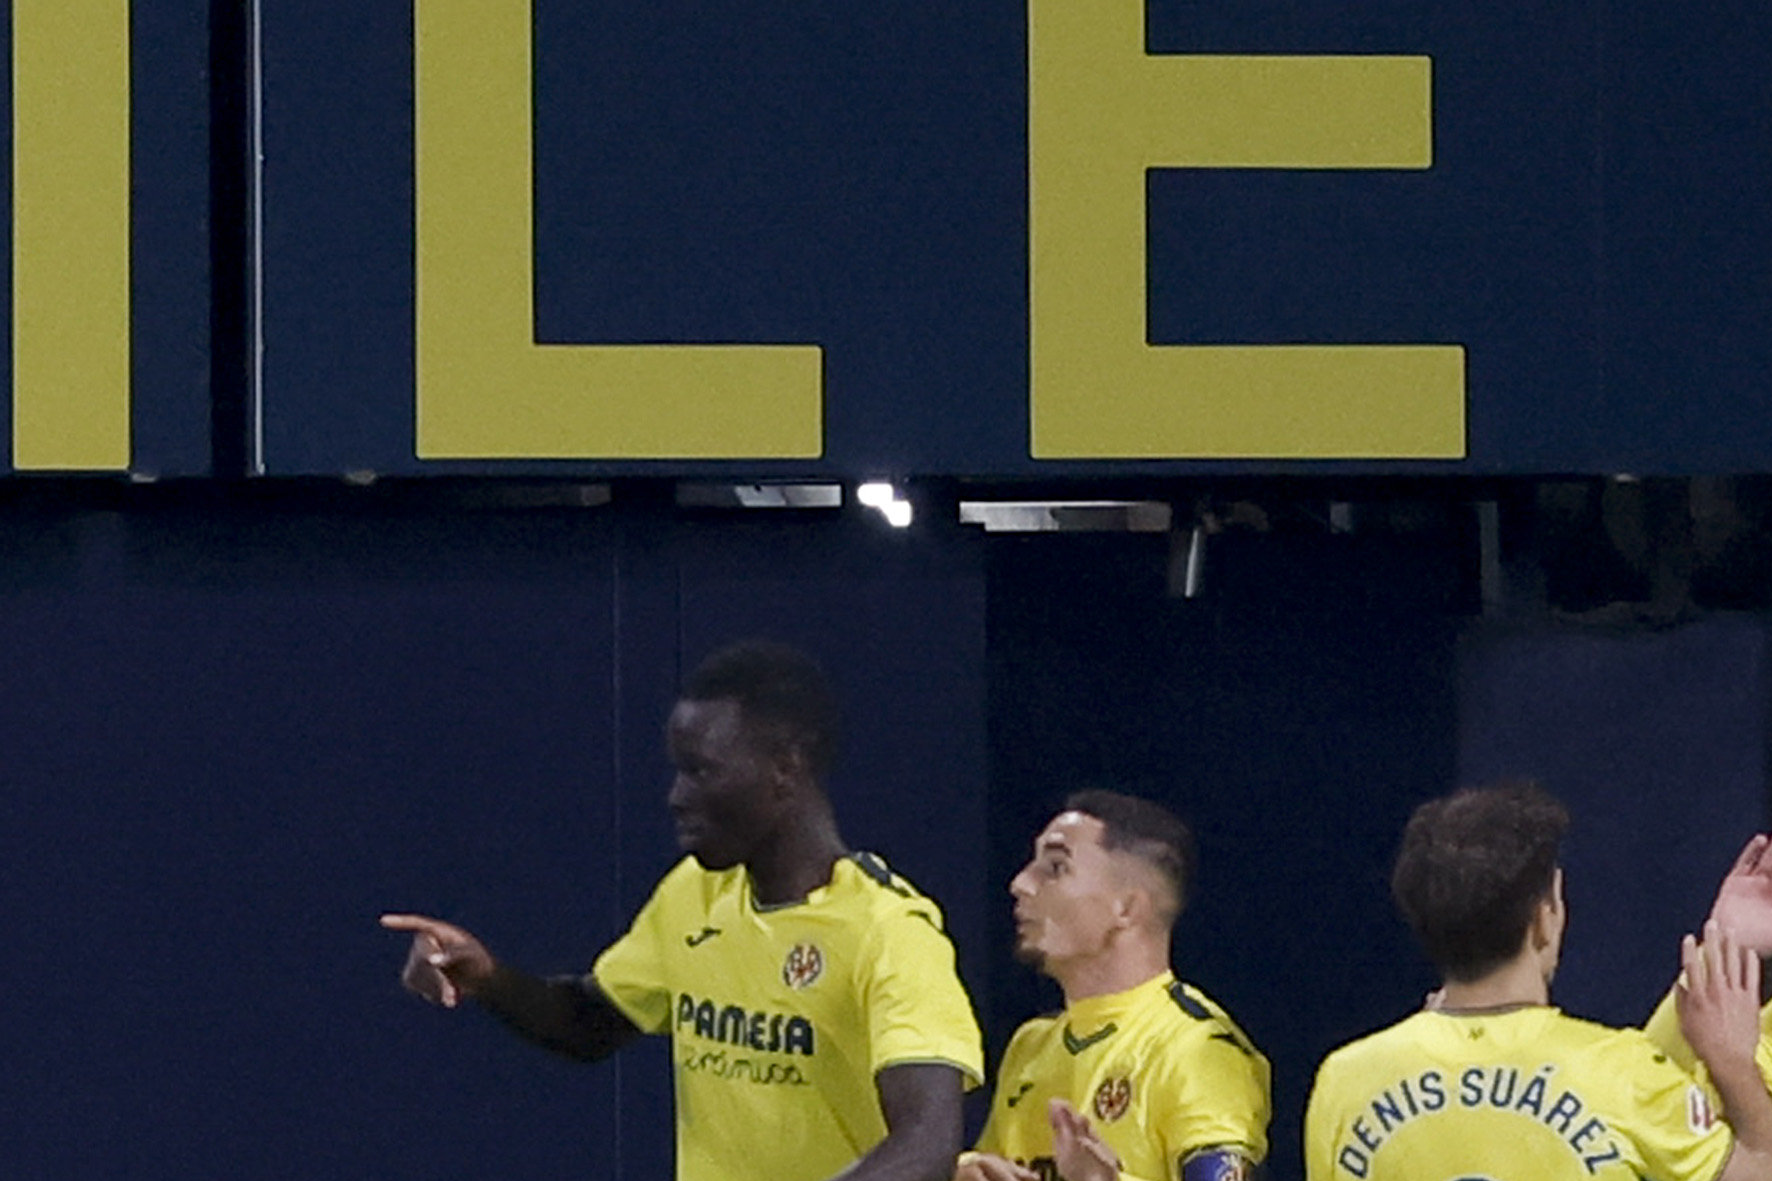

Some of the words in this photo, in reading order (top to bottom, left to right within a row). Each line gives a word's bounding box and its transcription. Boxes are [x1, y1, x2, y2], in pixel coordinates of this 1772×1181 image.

[677, 992, 815, 1056] PAMESA
[1338, 1071, 1445, 1180] DENIS
[1459, 1065, 1621, 1176] SUÁREZ
